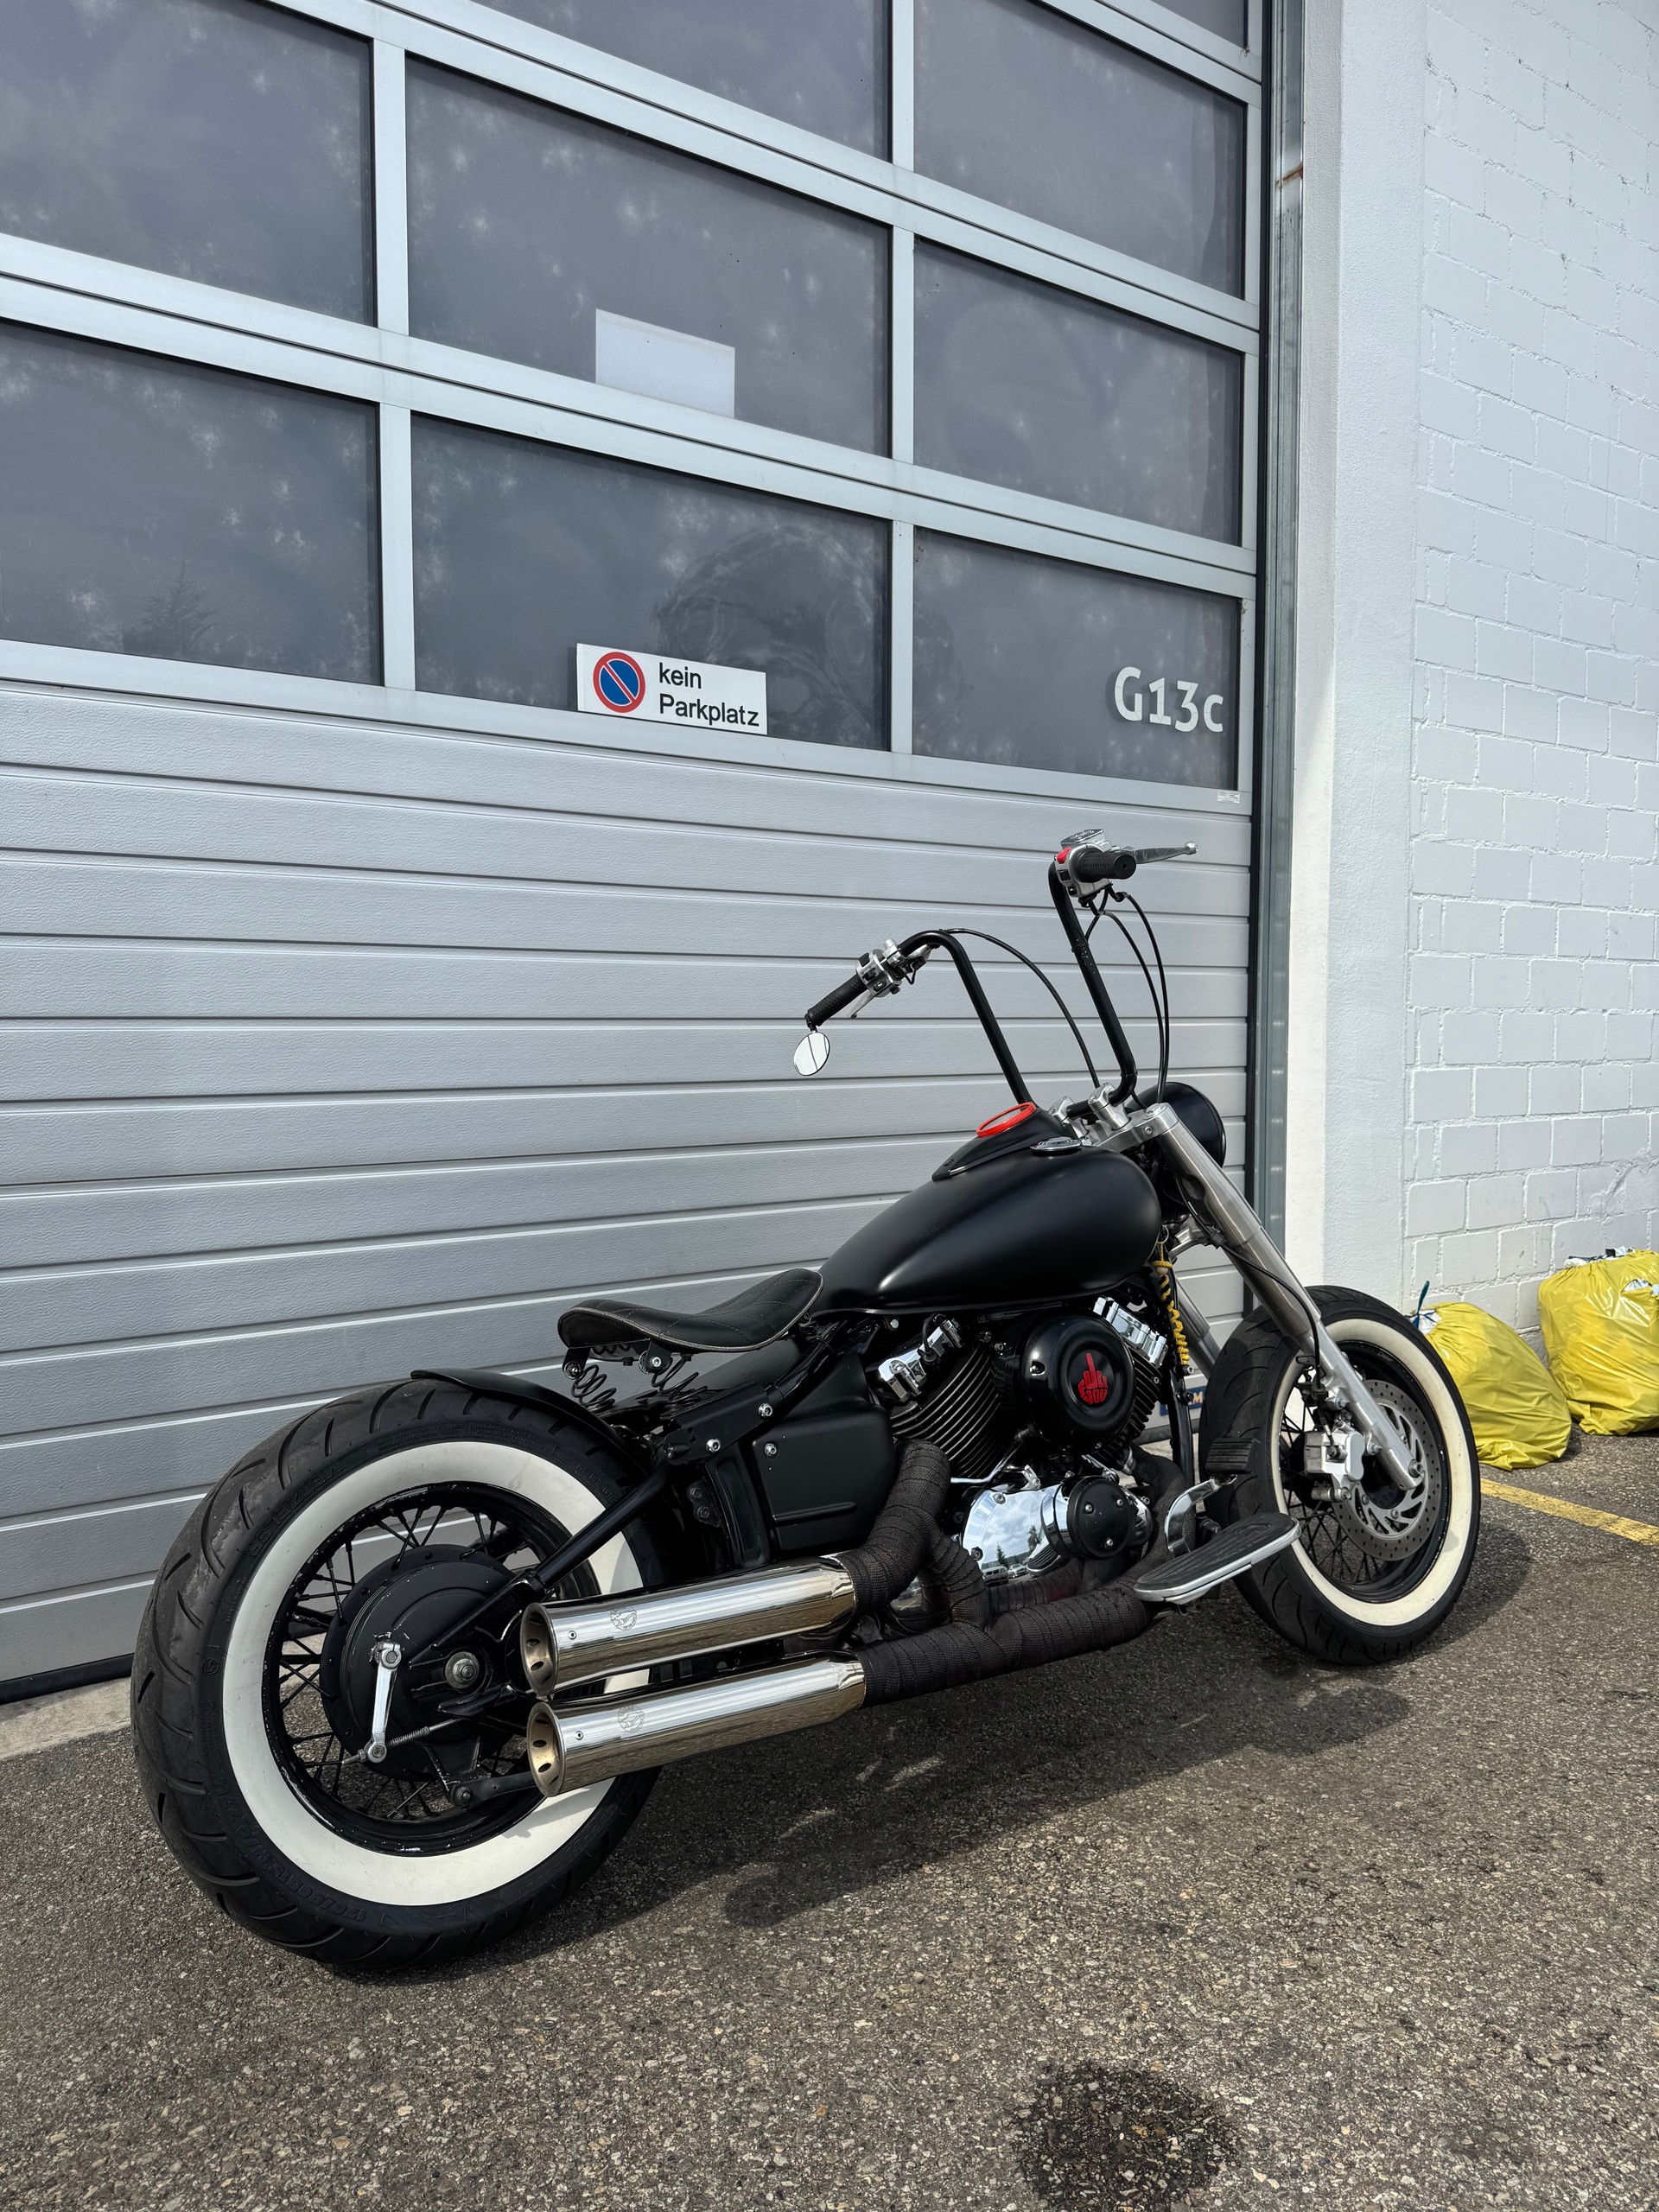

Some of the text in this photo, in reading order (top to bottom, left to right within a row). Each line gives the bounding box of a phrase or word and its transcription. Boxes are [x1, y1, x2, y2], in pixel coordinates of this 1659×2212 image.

[658, 662, 702, 690] kein
[1114, 666, 1224, 733] G13c
[659, 693, 760, 727] Parkplatz
[245, 1457, 344, 1558] METZELER
